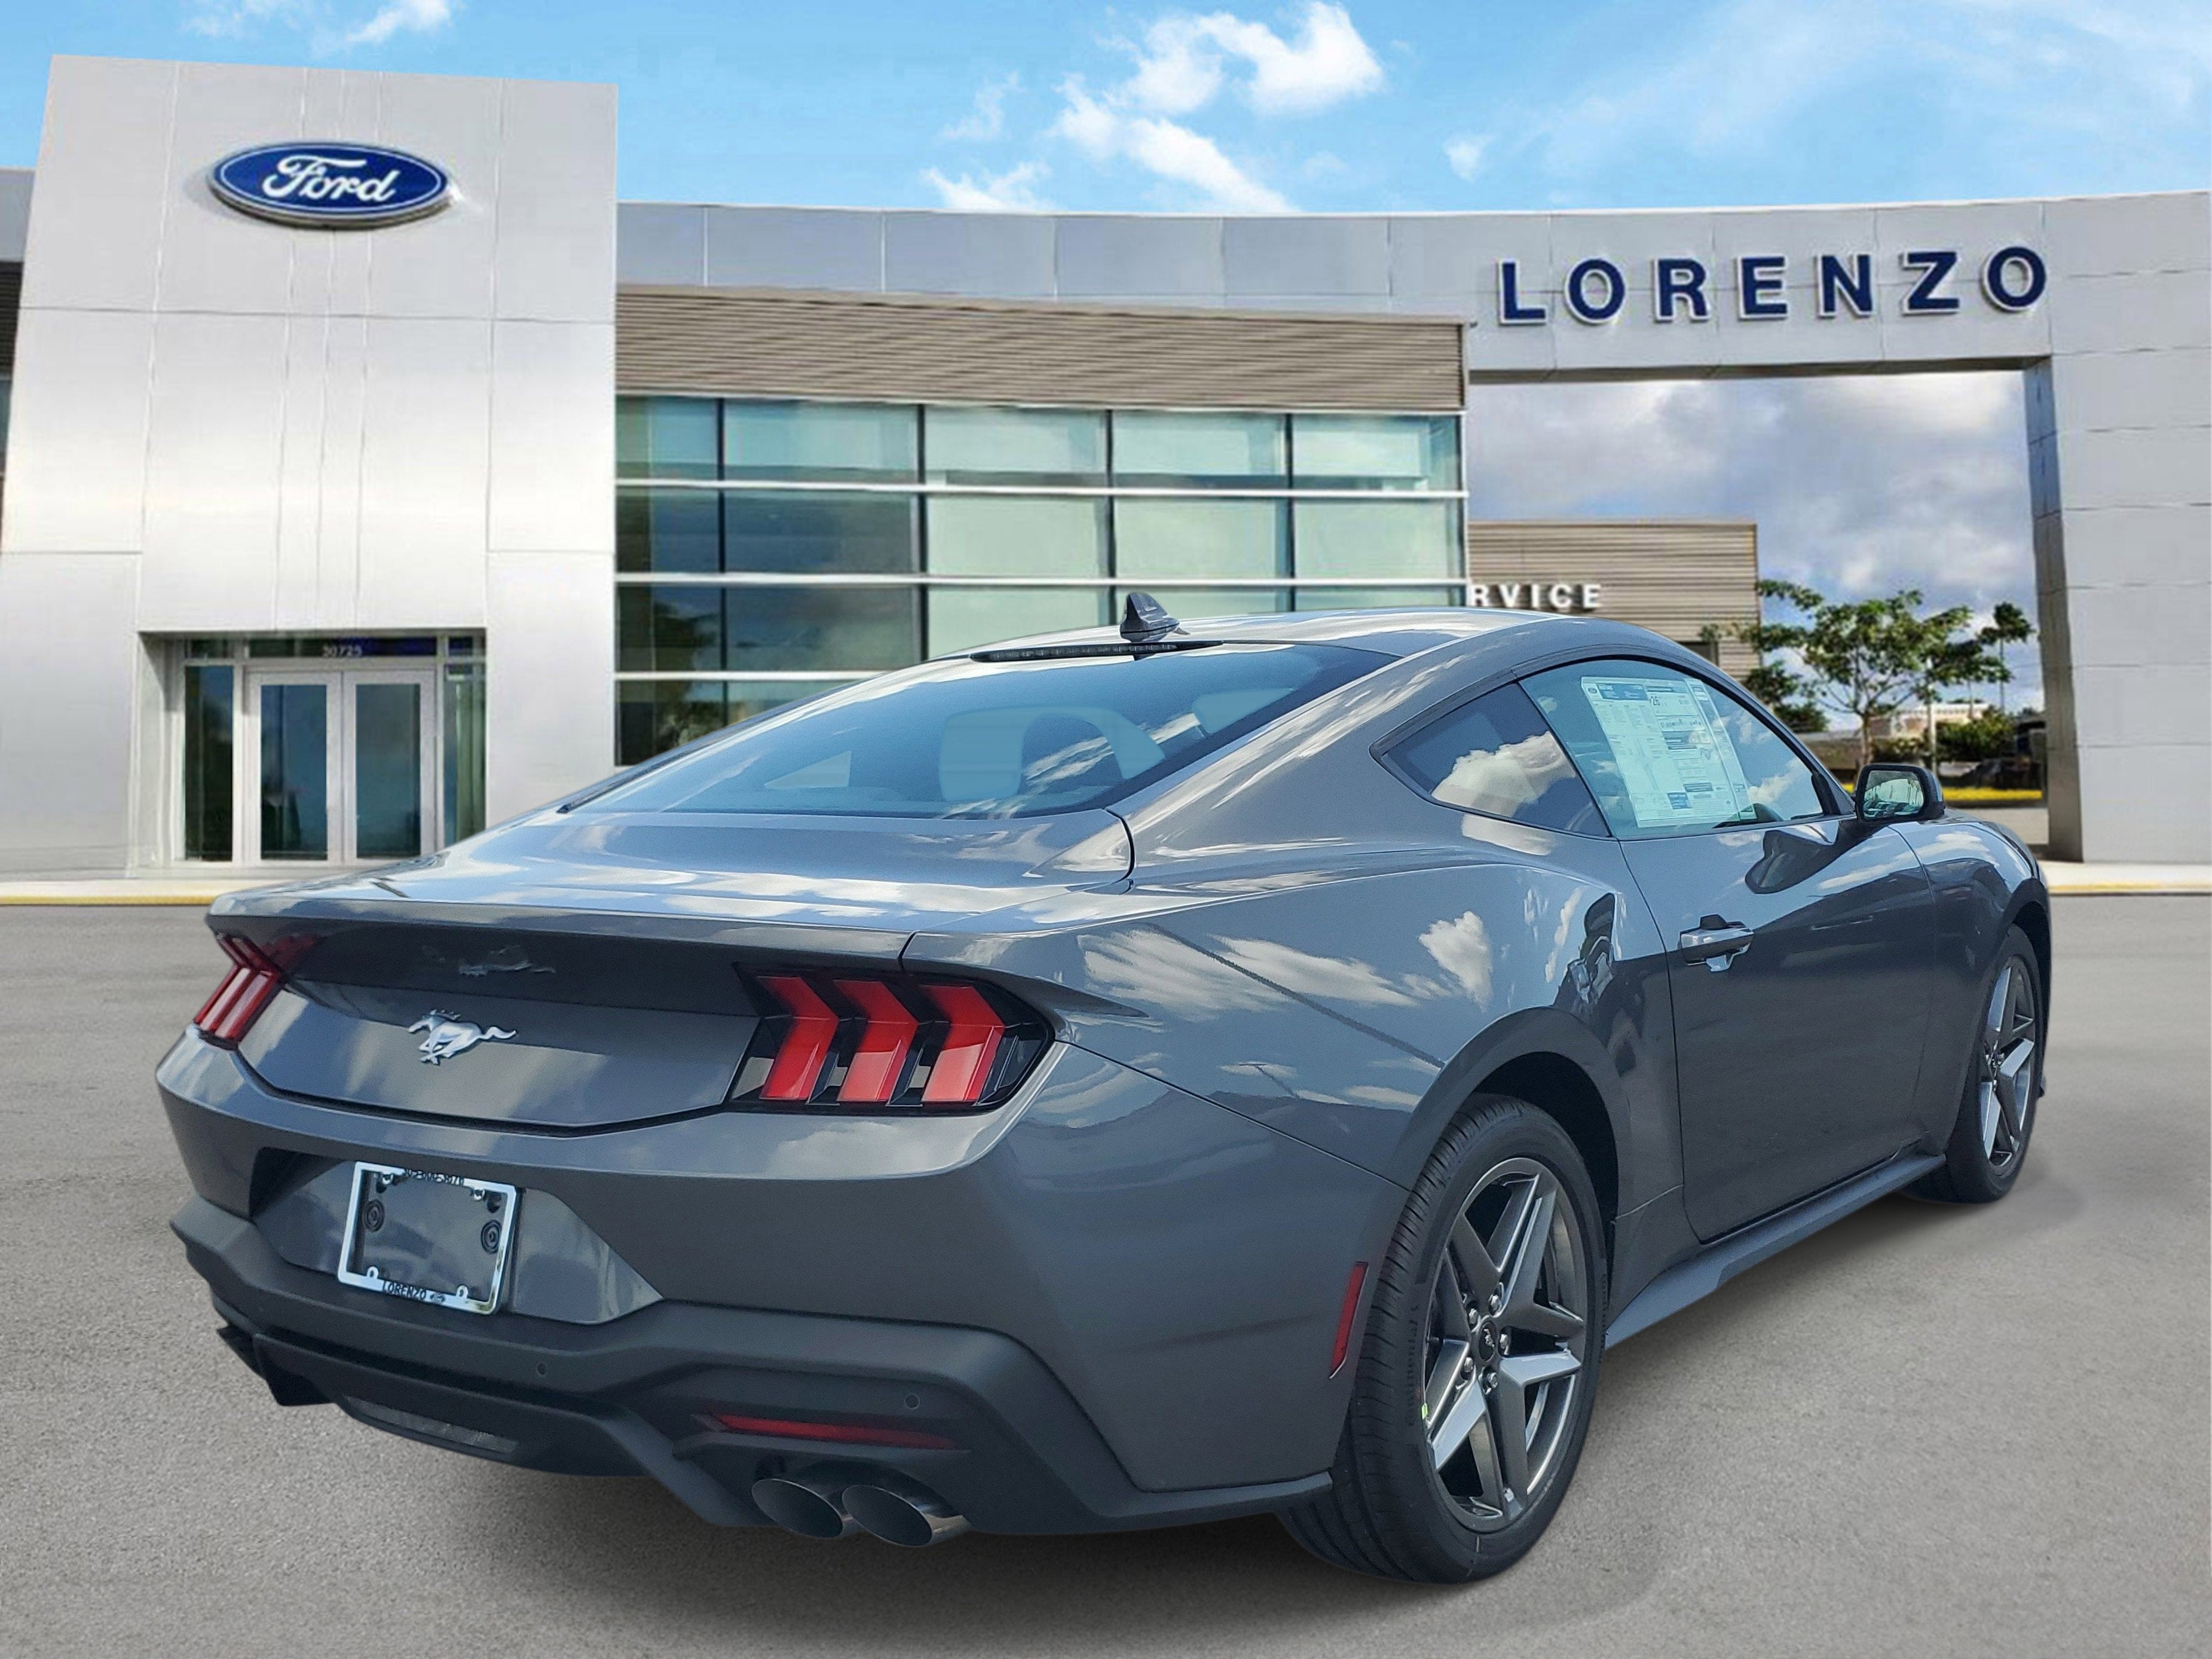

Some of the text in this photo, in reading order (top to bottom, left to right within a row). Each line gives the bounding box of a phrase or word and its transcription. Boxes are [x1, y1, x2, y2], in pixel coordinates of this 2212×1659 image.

[262, 154, 400, 201] Ford
[1498, 246, 2046, 325] LORENZO
[383, 1281, 426, 1302] LORENZO
